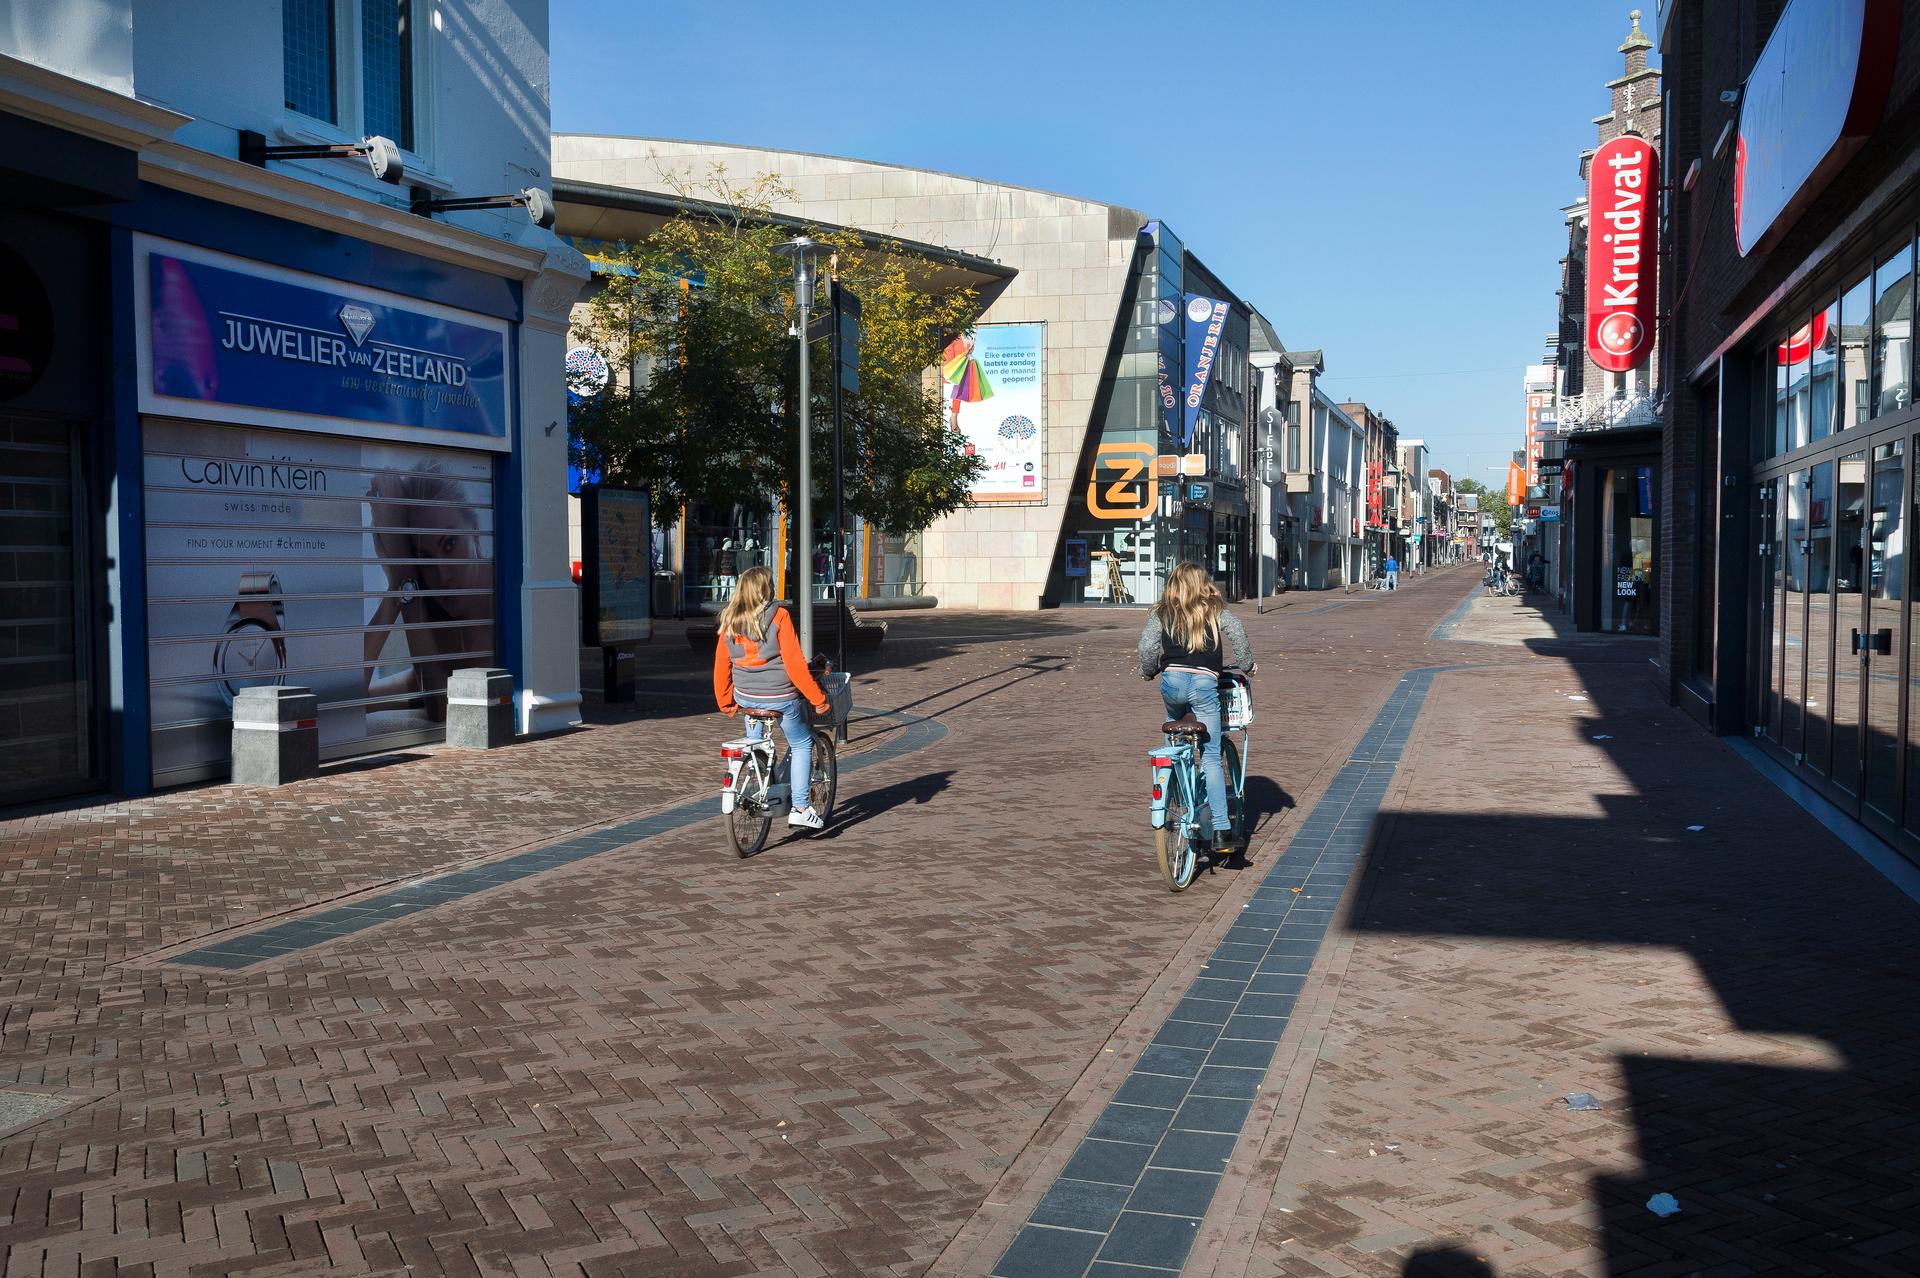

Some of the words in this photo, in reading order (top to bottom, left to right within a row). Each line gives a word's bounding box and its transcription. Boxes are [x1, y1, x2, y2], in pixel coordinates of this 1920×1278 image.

[1603, 151, 1642, 307] Kruidvat
[221, 319, 347, 367] JUWELIER
[349, 351, 372, 366] VAN
[372, 347, 467, 387] ZEELAND
[1009, 359, 1036, 367] zondag
[1187, 302, 1229, 408] ORANJERIE
[341, 376, 360, 389] uw
[364, 378, 434, 402] vertrouwde
[433, 387, 481, 413] juwelier
[1002, 376, 1036, 384] geopend!
[182, 453, 265, 486] Calvin
[271, 455, 327, 492] Klein
[224, 501, 256, 512] swiss
[261, 502, 292, 514] made
[1369, 461, 1382, 526] HEMA
[187, 539, 208, 549] FIND
[210, 539, 234, 549] YOUR
[237, 539, 273, 549] MOMENT
[276, 537, 326, 551] #ckminute
